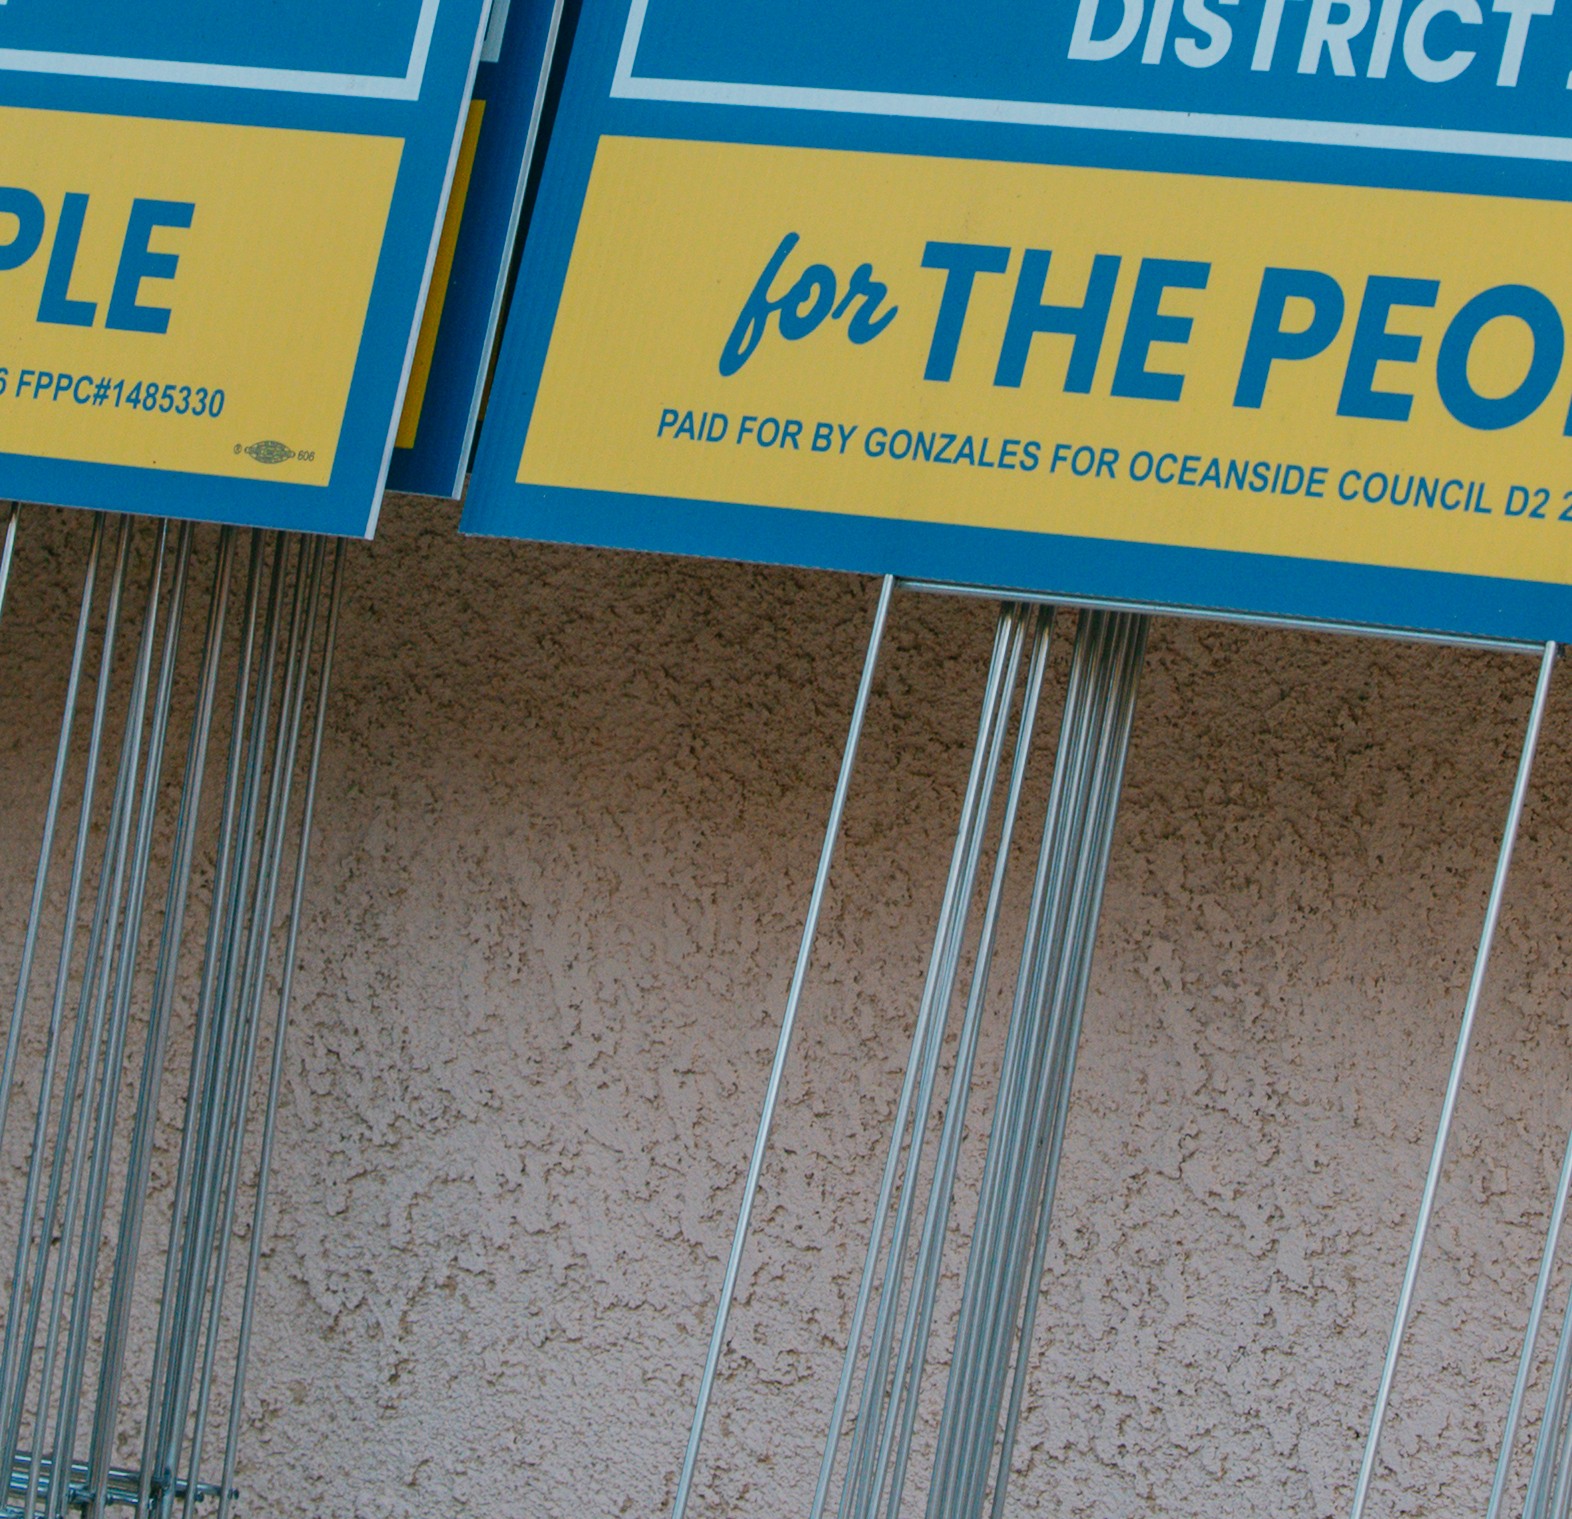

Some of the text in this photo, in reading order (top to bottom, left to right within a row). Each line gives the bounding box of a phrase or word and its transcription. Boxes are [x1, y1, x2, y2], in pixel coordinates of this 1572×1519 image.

[718, 231, 899, 378] for
[920, 240, 1212, 403] THE
[15, 369, 225, 419] FPPC#1485330
[297, 450, 315, 462] 606
[656, 408, 729, 443] PAID
[736, 415, 804, 450] FOR
[810, 422, 858, 454] BY
[864, 426, 1042, 472] GONZALES
[1049, 443, 1120, 479] FOR
[1129, 450, 1330, 498] OCEANSIDE
[1338, 469, 1493, 515] COUNCIL
[1504, 485, 1551, 520] D2
